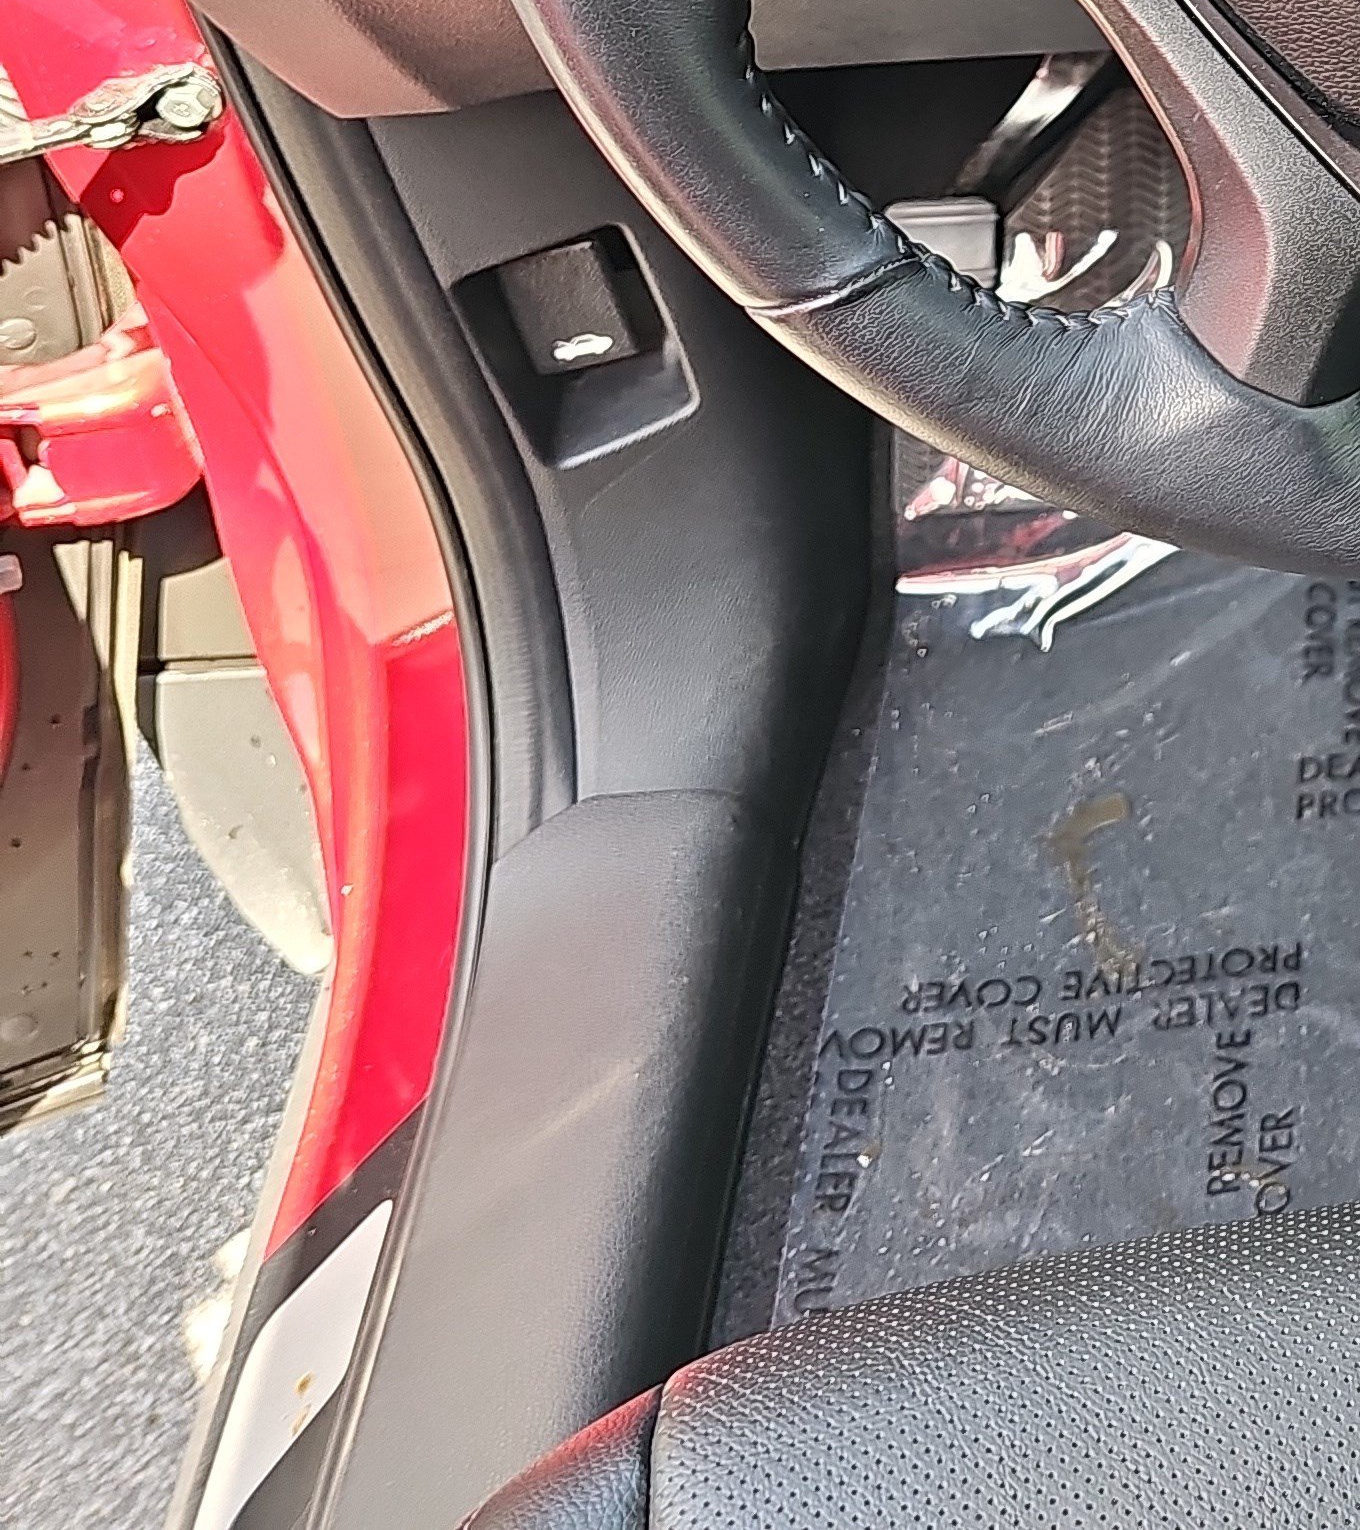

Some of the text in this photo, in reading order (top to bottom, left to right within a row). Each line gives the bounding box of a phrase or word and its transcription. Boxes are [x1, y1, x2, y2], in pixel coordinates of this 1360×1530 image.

[1303, 582, 1337, 686] COVER
[819, 980, 1300, 1061] DEALER MUST REMOV
[903, 941, 1302, 1016] PROTECTIVE COVER
[1206, 1029, 1253, 1198] REMOVE
[1254, 1107, 1296, 1216] OVER
[796, 1068, 871, 1316] DEALER MU
